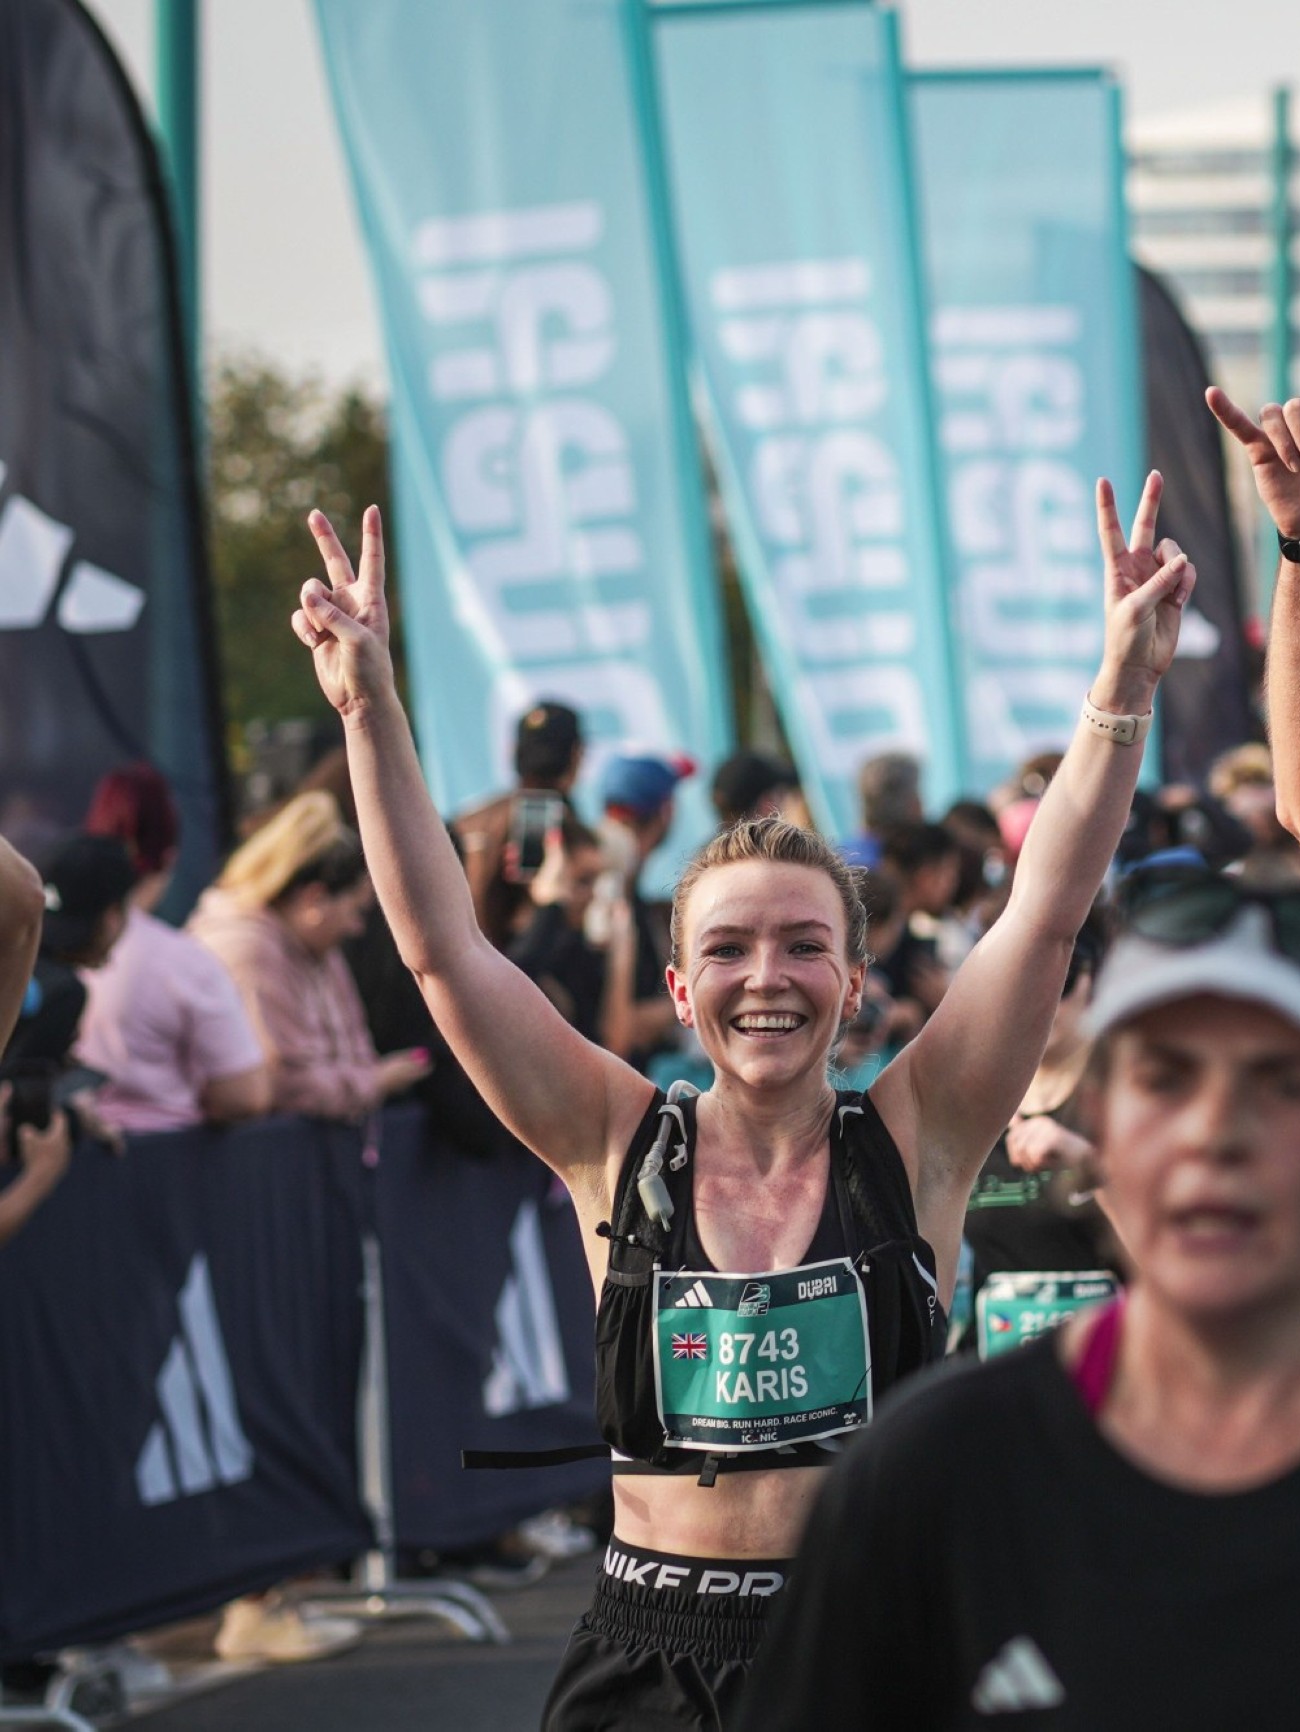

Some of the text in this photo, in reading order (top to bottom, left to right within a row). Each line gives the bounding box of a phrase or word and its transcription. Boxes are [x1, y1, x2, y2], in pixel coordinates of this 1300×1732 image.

[797, 1276, 837, 1300] DUBAI
[718, 1328, 800, 1366] 8743
[716, 1365, 809, 1403] KARIS
[692, 1407, 838, 1429] DREAM BIG. RUN HARD. RACE ICONIC.
[741, 1432, 778, 1444] ICNIC
[696, 1569, 786, 1597] PR
